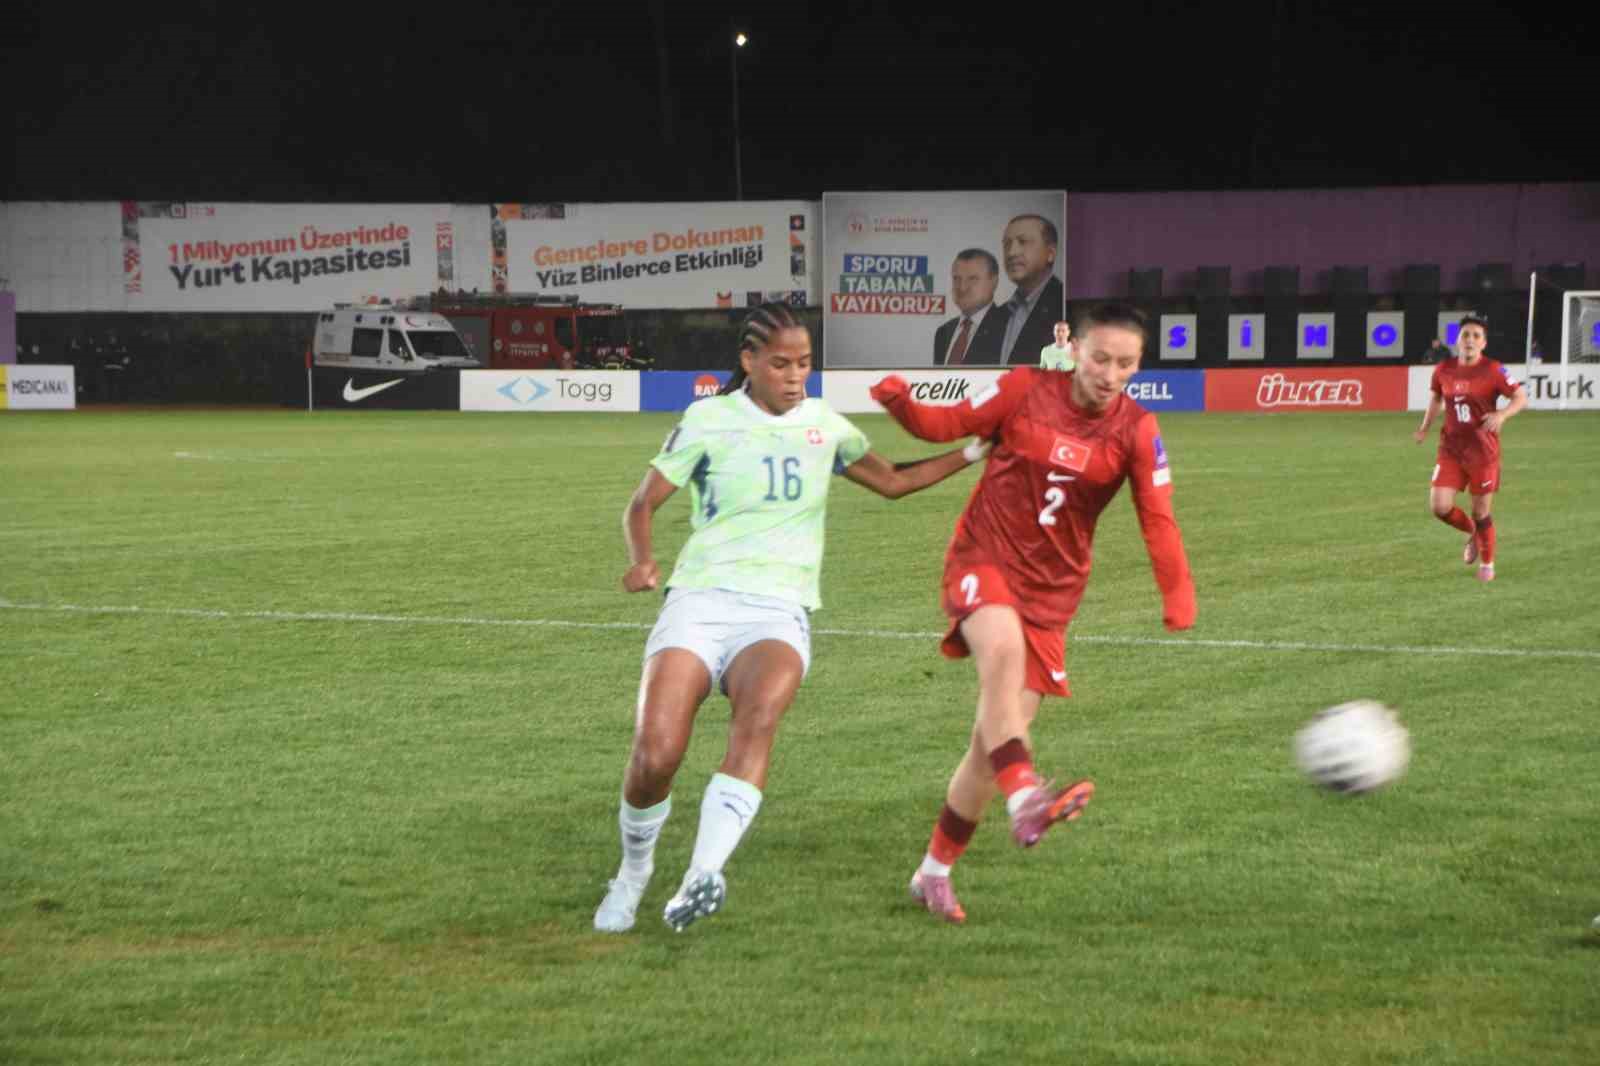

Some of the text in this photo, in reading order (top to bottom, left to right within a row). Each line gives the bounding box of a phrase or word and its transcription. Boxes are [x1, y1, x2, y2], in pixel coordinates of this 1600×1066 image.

[168, 223, 410, 264] 1 Milyonun Üzerinde
[534, 224, 764, 267] Gençlere Dokunan
[170, 243, 411, 289] Yurt Kapasitesi
[536, 245, 764, 288] Yüz Binlerce Etkinliği
[851, 256, 918, 274] SPORU
[845, 276, 926, 293] TABANA
[834, 295, 944, 314] YAYIYORUZ
[12, 378, 64, 395] MEDICANA
[556, 378, 613, 402] Togg
[694, 383, 721, 397] RAY
[910, 377, 970, 400] rcelik
[1256, 373, 1364, 407] ÜLKER
[1520, 374, 1595, 400] Turk
[1454, 402, 1472, 424] 18
[761, 456, 803, 502] 16
[1038, 486, 1067, 527] 2
[959, 573, 982, 607] 2
